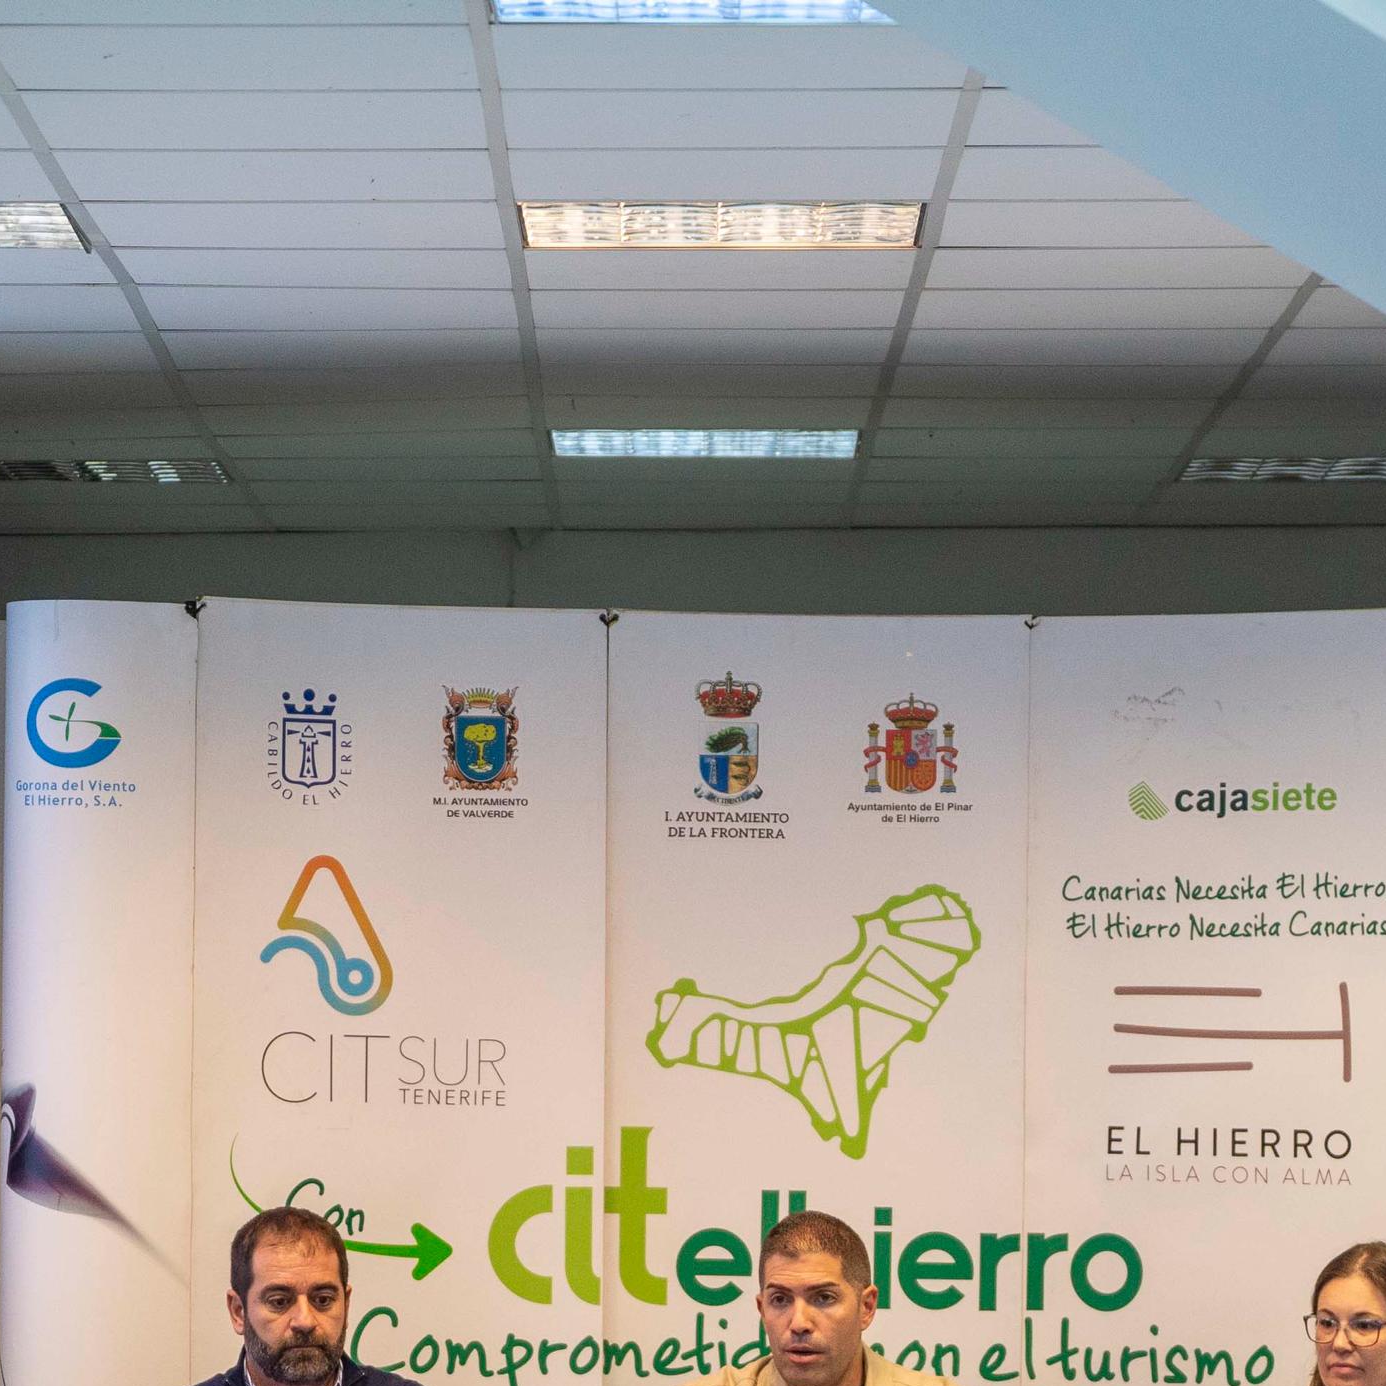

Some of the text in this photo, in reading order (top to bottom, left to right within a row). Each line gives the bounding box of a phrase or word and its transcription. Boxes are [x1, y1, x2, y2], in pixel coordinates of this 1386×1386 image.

[267, 721, 353, 806] CABILDO EL HIERRO
[16, 779, 136, 793] Gorona del Viento
[24, 795, 123, 809] El Hierro, S.A.
[451, 798, 529, 806] AYUNTAMIENTO
[1174, 781, 1338, 819] cajasiete
[446, 809, 515, 819] DE VALVERDE
[847, 802, 973, 813] Ayuntamiento de El Pinar
[664, 811, 790, 824] I. AYUNTAMIENTO
[881, 814, 940, 823] de El Hierro
[668, 826, 785, 840] DE LA FRONTERA
[1062, 875, 1166, 902] Canarias
[1175, 874, 1268, 903] Necesita
[1276, 872, 1305, 899] El
[1067, 912, 1097, 939] El
[1104, 911, 1181, 940] Hierro
[1189, 911, 1281, 941] Necesita
[399, 1088, 507, 1107] TENERIFE
[1107, 1126, 1352, 1160] EL HIERRO
[1105, 1164, 1352, 1186] LA ISLA CON ALMA
